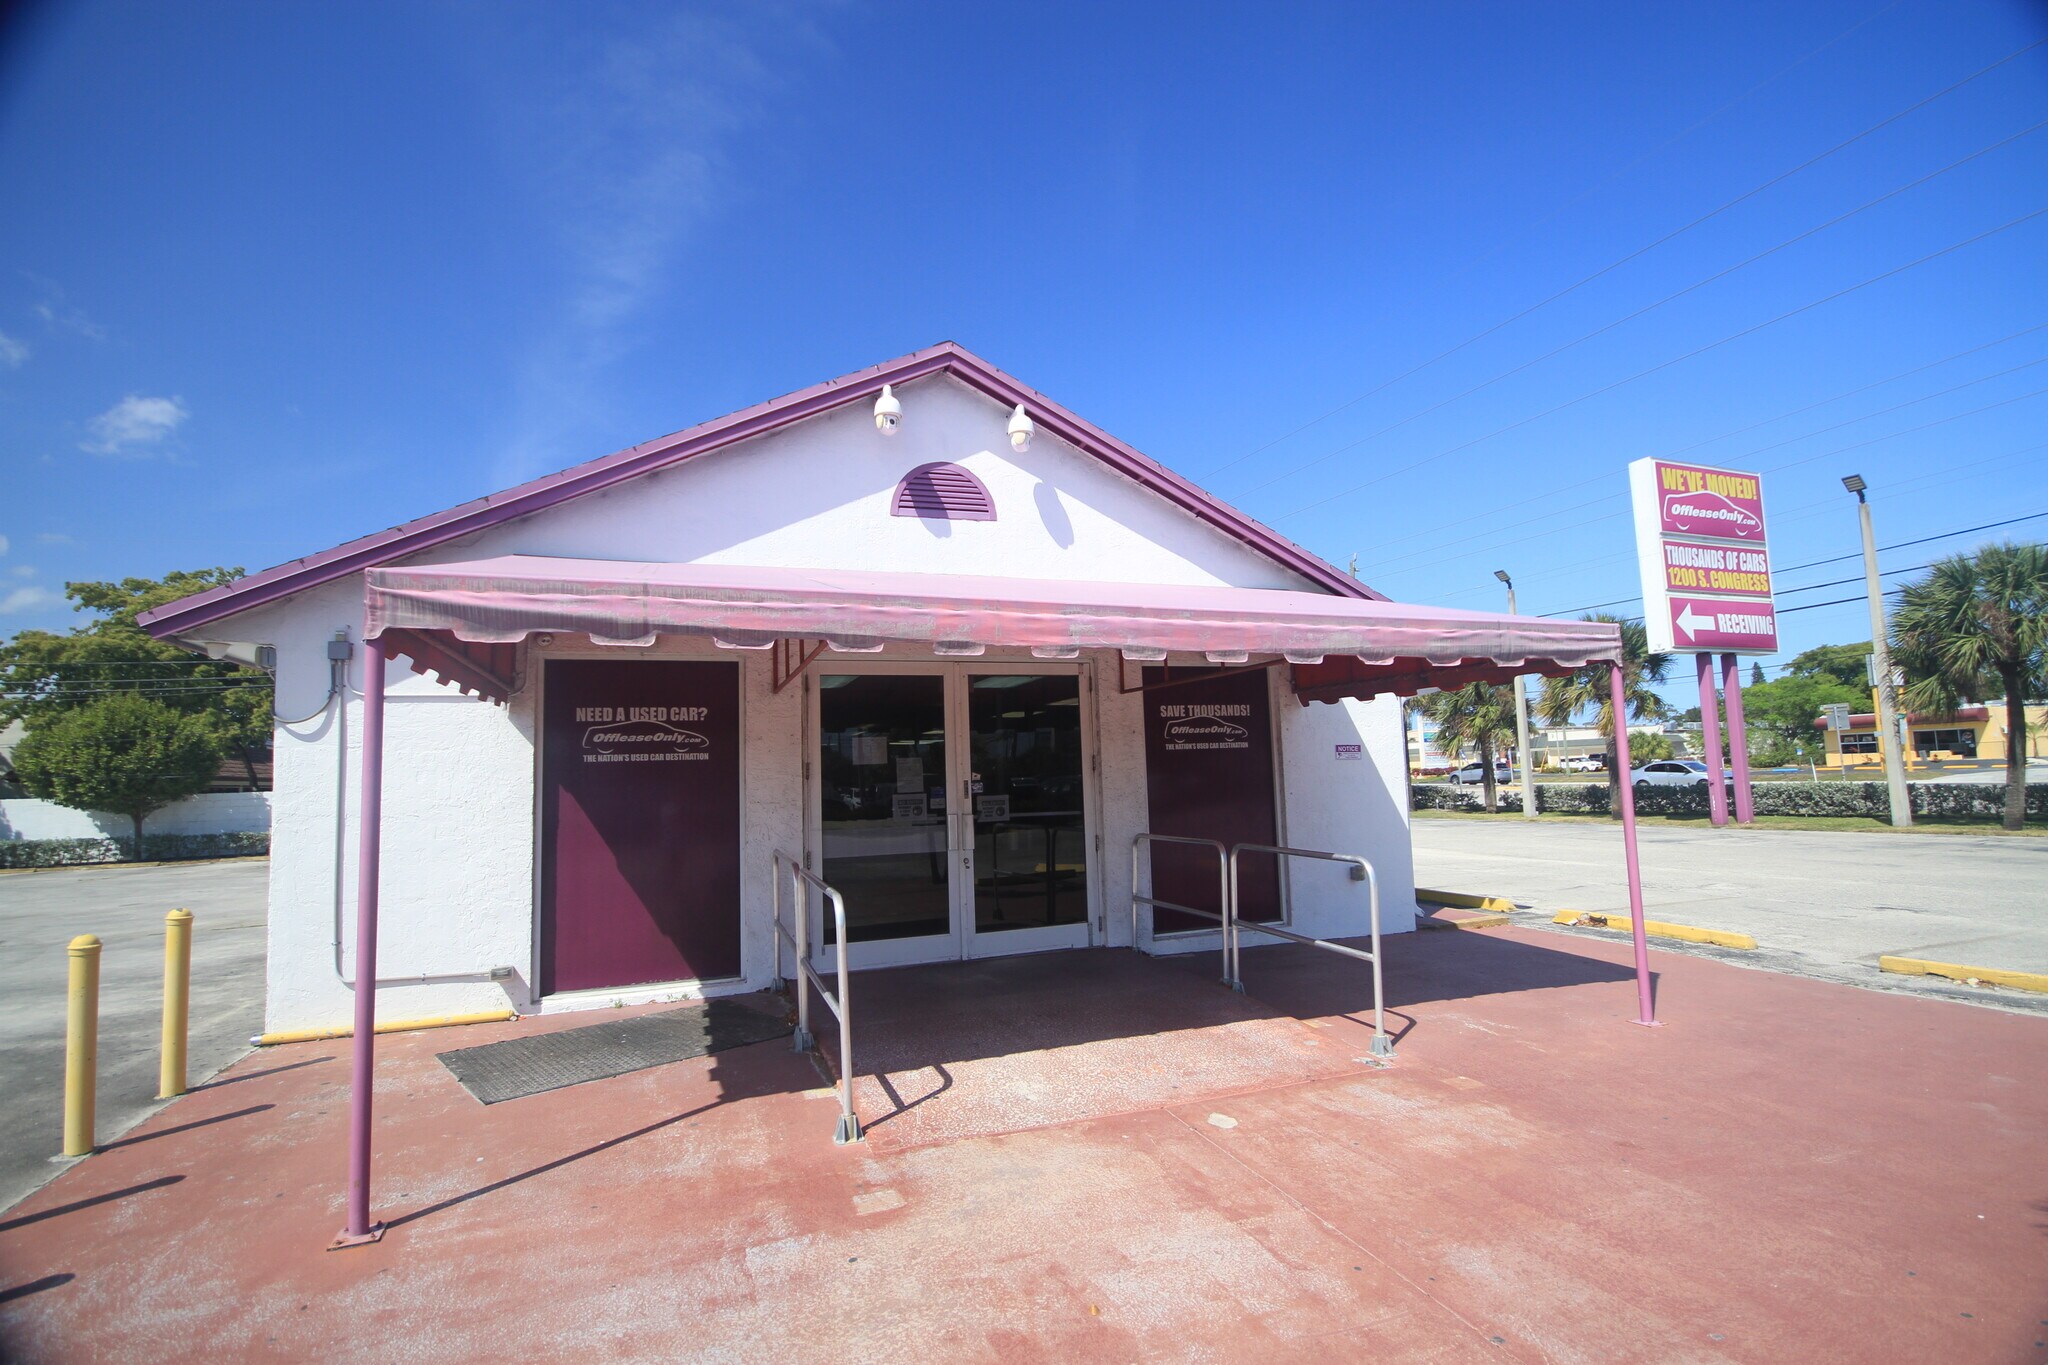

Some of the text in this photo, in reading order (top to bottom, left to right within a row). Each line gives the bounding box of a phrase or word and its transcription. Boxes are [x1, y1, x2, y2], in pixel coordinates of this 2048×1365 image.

[1661, 467, 1757, 500] WE'VE MOVED!
[1671, 504, 1756, 525] OffleaseOnly.com
[1665, 545, 1766, 572] THOUSANDS OF CARS
[1668, 567, 1768, 592] 1200 S. CONGRESS
[1717, 613, 1774, 635] RECEIVING
[576, 707, 708, 722] NEED A USED CAR?
[1160, 704, 1250, 717] SAVE THOUSANDS!
[583, 753, 709, 762] THE NATION'S USED CAR DESTINATION
